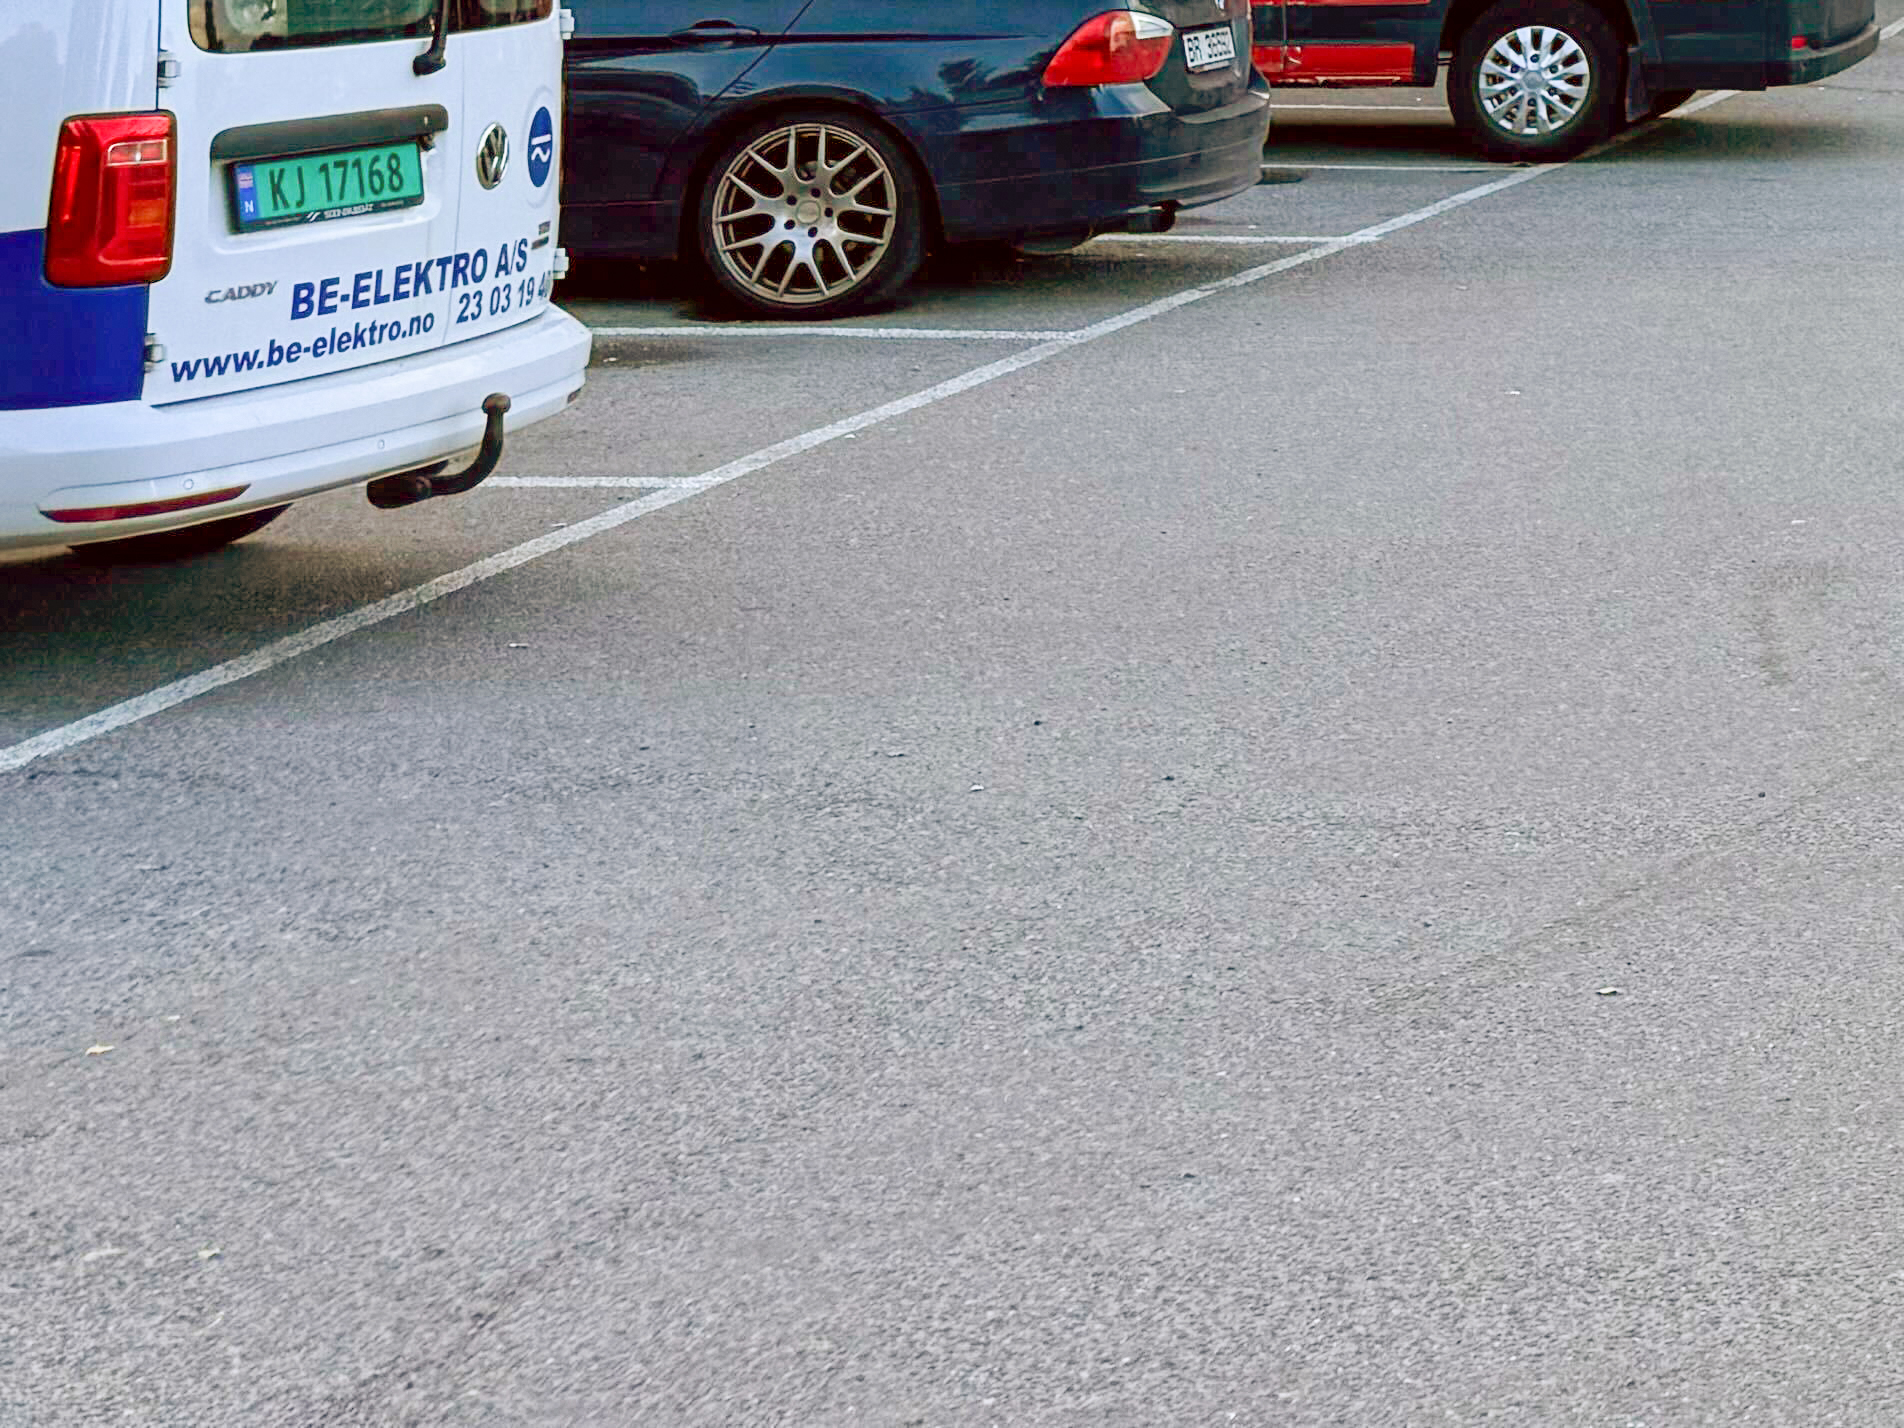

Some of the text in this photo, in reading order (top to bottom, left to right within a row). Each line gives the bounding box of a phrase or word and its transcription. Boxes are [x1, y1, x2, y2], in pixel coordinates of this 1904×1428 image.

[268, 152, 404, 211] KJ 17168
[204, 280, 278, 304] CADDY
[289, 238, 528, 321] BE-ELEKTRO A/S
[171, 311, 435, 383] www.be-elektro.no
[456, 290, 483, 324] 23
[489, 283, 512, 316] 03
[518, 276, 535, 308] 19
